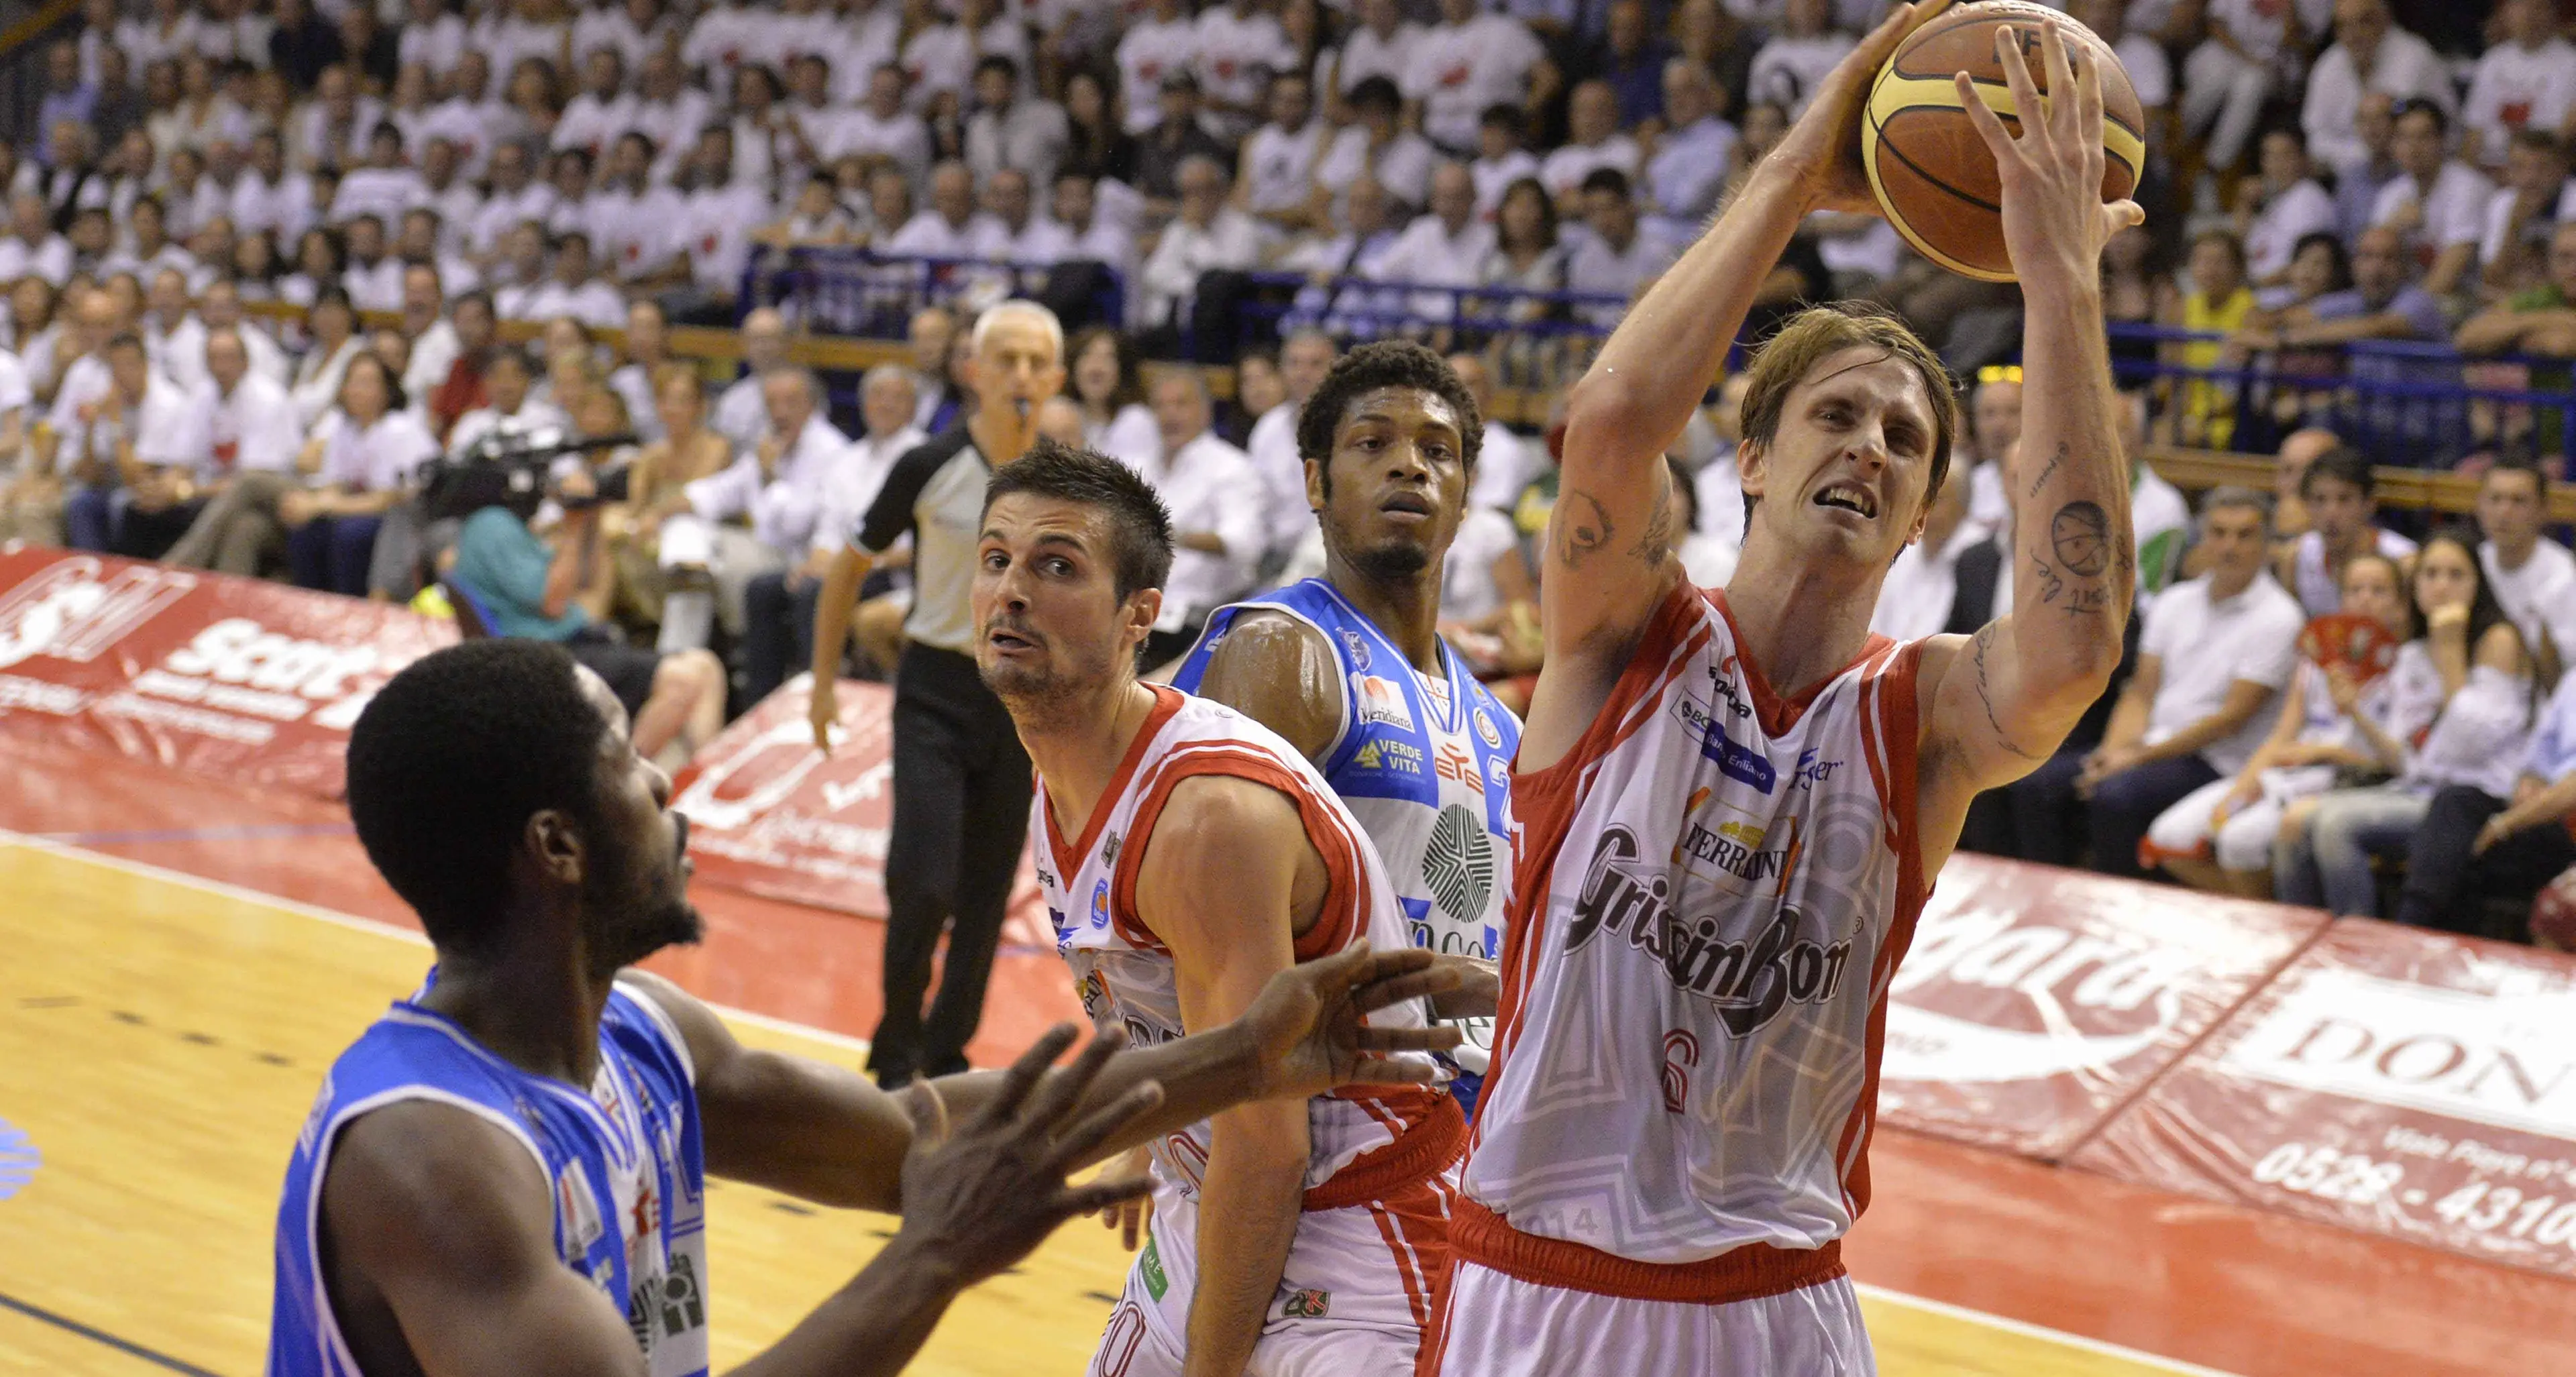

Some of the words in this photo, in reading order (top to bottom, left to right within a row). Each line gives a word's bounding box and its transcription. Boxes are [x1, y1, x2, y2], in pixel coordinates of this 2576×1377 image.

[1379, 739, 1423, 761] VERDE
[1388, 755, 1420, 775] VITA
[2434, 1180, 2576, 1246] 4310
